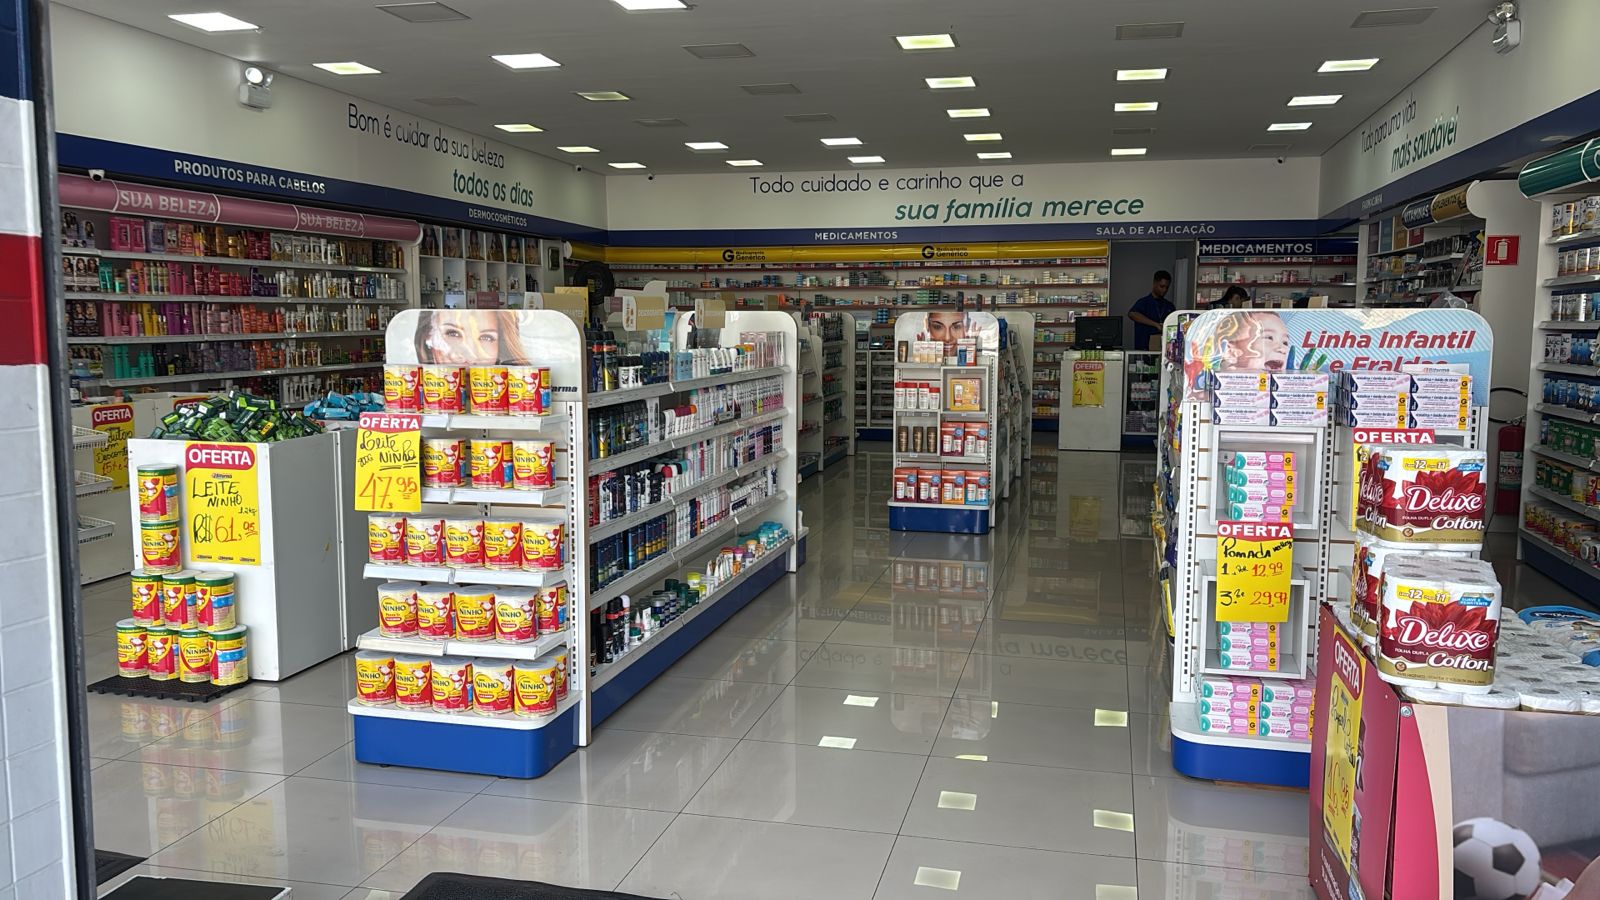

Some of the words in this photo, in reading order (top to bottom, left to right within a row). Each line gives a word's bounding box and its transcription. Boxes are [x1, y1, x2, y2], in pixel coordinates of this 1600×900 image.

[348, 103, 380, 136] Bom
[384, 114, 392, 138] é
[396, 121, 431, 149] cuidar
[433, 132, 448, 154] da
[451, 141, 469, 159] sua
[472, 138, 505, 169] beleza
[1391, 136, 1412, 172] mais
[1412, 106, 1459, 160] saudável
[174, 159, 244, 182] PRODUTOS
[246, 171, 277, 187] PARA
[278, 175, 326, 194] CABELOS
[749, 176, 794, 194] Todo
[801, 173, 872, 193] cuidado
[878, 178, 889, 191] e
[896, 170, 962, 190] carinho
[969, 174, 1004, 195] que
[1011, 174, 1024, 187] a
[453, 168, 489, 199] todos
[493, 181, 506, 202] os
[510, 181, 533, 208] dias
[120, 190, 153, 210] SUA
[159, 195, 217, 216] BELEZA
[894, 203, 938, 220] sua
[943, 197, 1031, 223] família
[1042, 198, 1144, 217] merece
[299, 213, 323, 227] SUA
[326, 216, 366, 234] BELEZA
[468, 208, 528, 227] DERMOCOSMÉTICOS
[814, 231, 898, 241] MEDICAMENTOS
[1096, 226, 1126, 236] SALA
[1129, 226, 1145, 235] DE
[1148, 223, 1216, 236] APLICAÇÃO
[1202, 243, 1313, 255] MEDICAMENTOS
[1301, 331, 1368, 350] Linha
[1378, 330, 1477, 350] Infantil
[1329, 358, 1345, 371] e
[94, 408, 132, 422] OFERTA
[360, 417, 419, 429] OFERTA
[360, 430, 399, 452] Leite
[1354, 431, 1433, 443] OFERTA
[188, 448, 252, 466] OFERTA
[1415, 460, 1427, 469] 12
[192, 478, 240, 499] LEITE
[207, 494, 242, 507] NINHO
[1405, 486, 1482, 511] Deluxe
[1218, 524, 1292, 538] OFERTA
[1432, 515, 1482, 530] Cotton
[1409, 589, 1422, 599] 12
[1436, 593, 1446, 602] 11
[1398, 617, 1489, 650] Deluxe
[1334, 640, 1360, 694] OFERTA
[1428, 652, 1489, 671] Cotton
